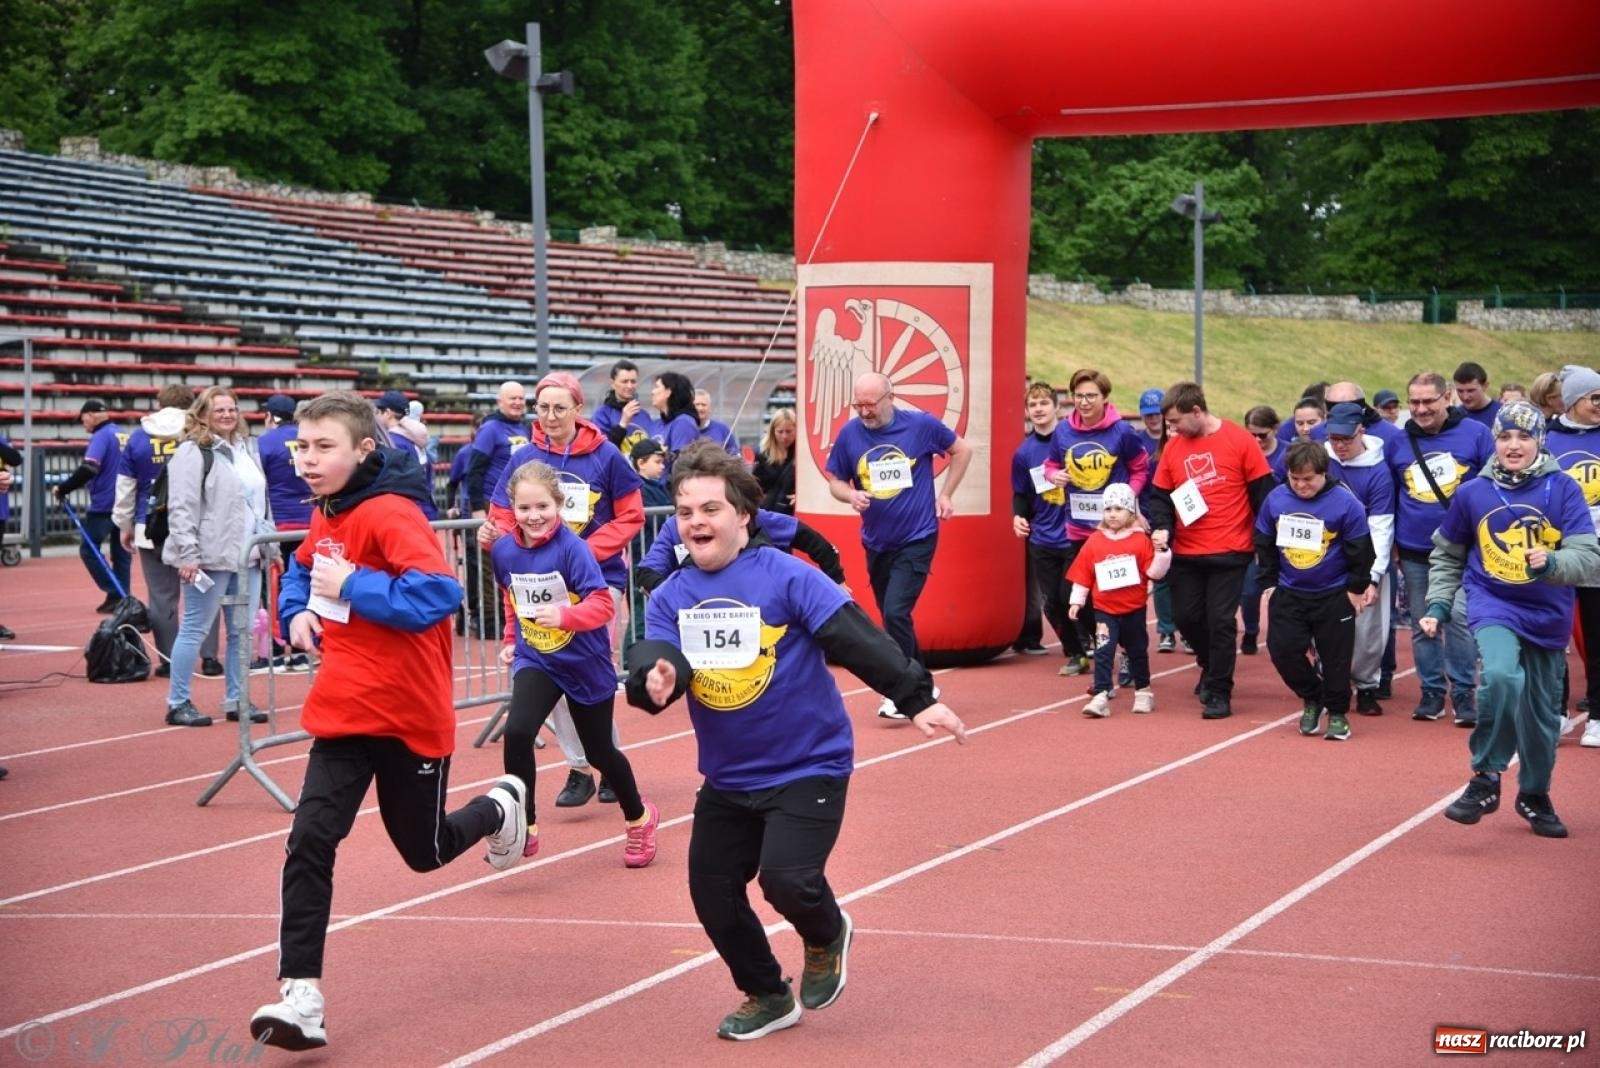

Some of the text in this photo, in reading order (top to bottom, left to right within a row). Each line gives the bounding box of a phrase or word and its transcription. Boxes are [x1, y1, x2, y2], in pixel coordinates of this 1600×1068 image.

[879, 469, 901, 480] 070
[1078, 502, 1097, 511] 054
[1290, 527, 1311, 539] 158
[1483, 543, 1523, 572] RACIBORSKI
[1108, 567, 1127, 579] 132
[525, 588, 552, 604] 166
[703, 629, 742, 648] 154
